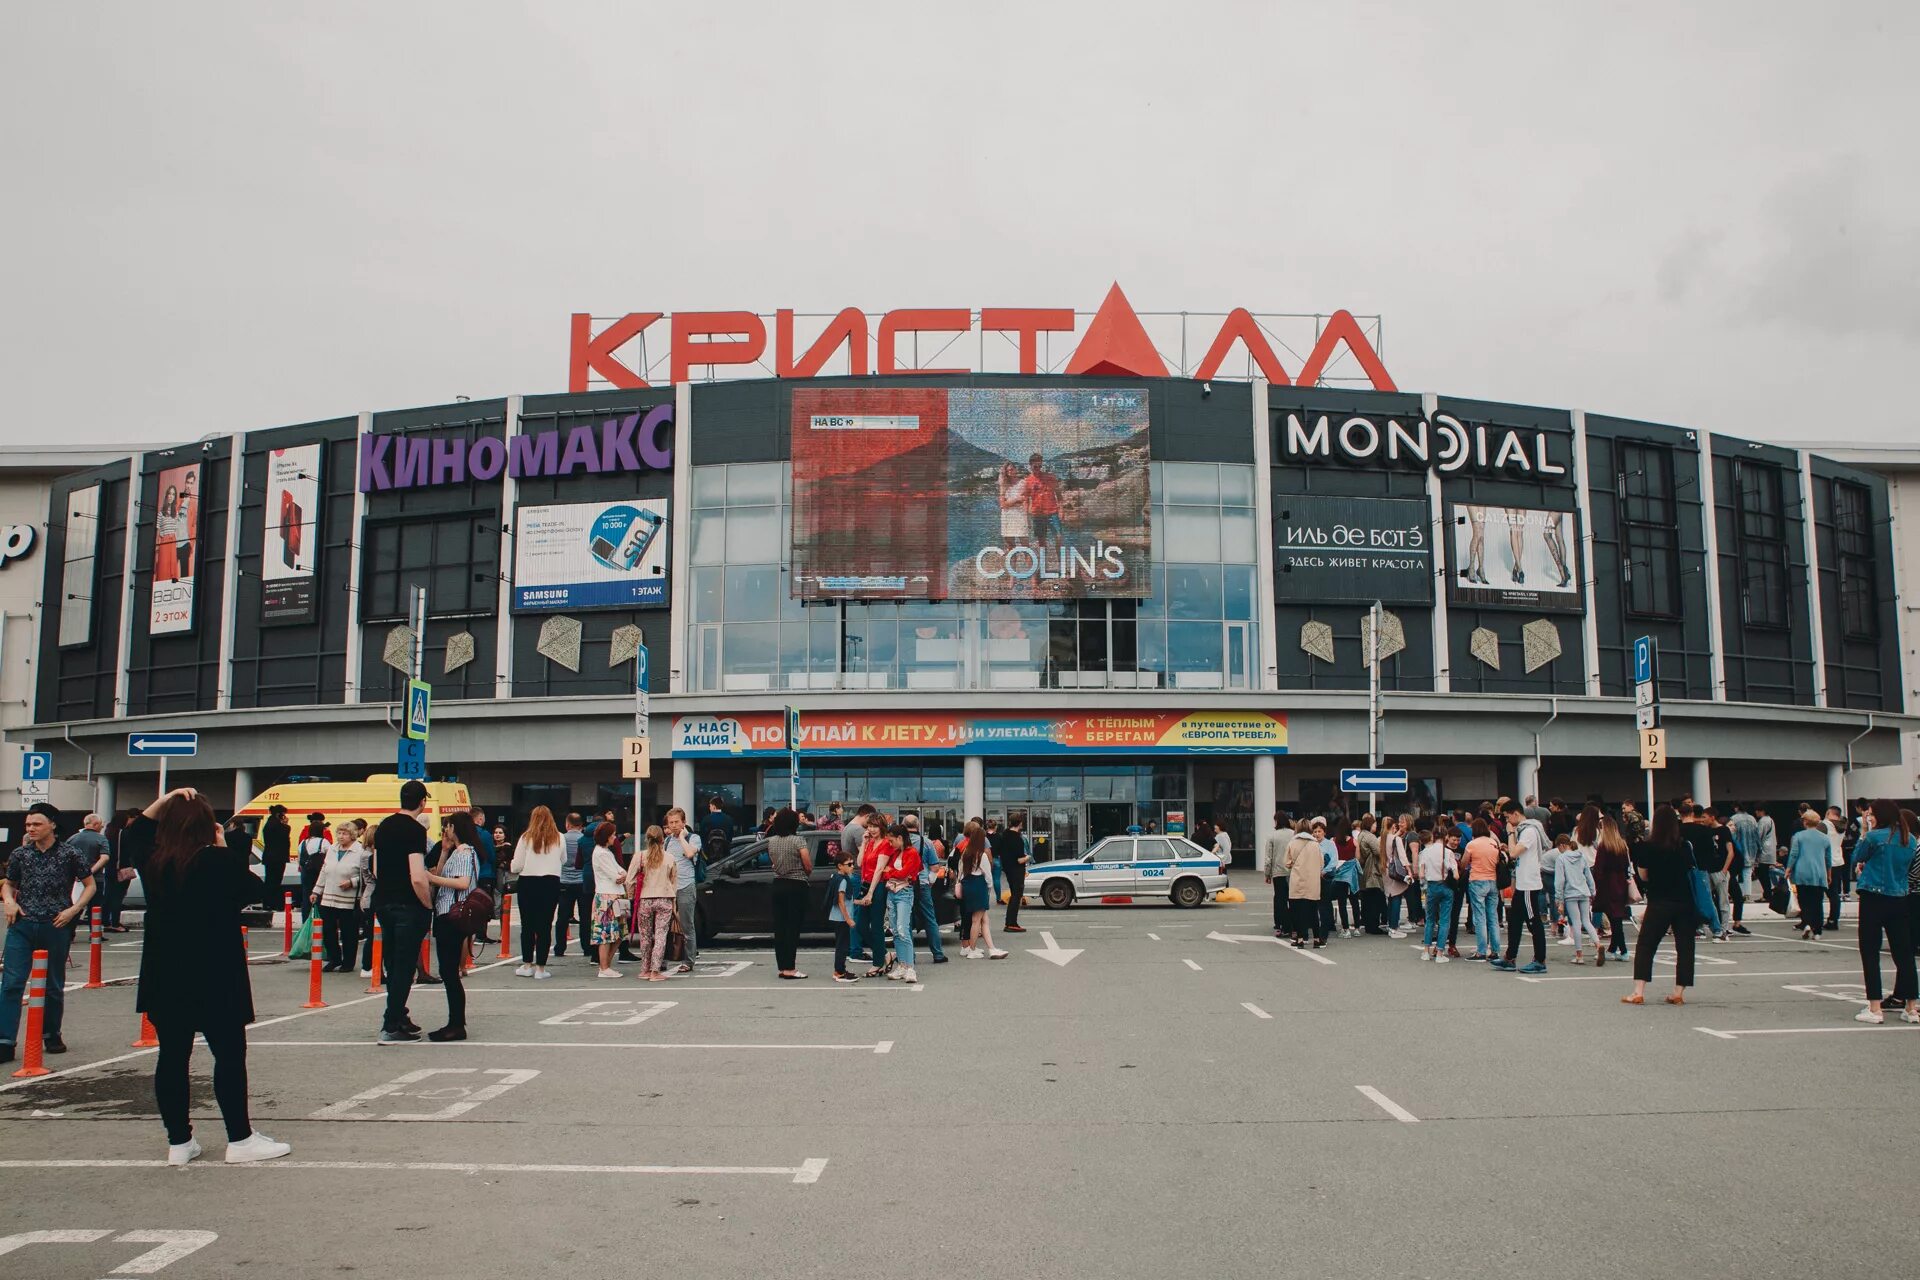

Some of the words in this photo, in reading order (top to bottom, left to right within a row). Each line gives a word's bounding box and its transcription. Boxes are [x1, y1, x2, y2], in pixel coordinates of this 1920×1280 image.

[569, 280, 1399, 393] КРИСТАЛЛ
[1092, 395, 1097, 406] 1
[360, 404, 674, 493] КИНОМАКС
[1287, 413, 1565, 474] MONDIAL
[1287, 526, 1328, 544] ИЛЬ
[624, 529, 650, 558] S10
[975, 540, 1125, 579] COLIN'S
[1288, 556, 1324, 567] ЗДЕСЬ
[1328, 557, 1367, 568] ЖИВЕТ
[1372, 559, 1424, 569] КРАСОТА
[523, 589, 569, 600] SAMSUNG
[632, 588, 636, 596] 1
[637, 586, 662, 595] ЭТАЖ
[155, 611, 160, 623] 2
[163, 611, 188, 622] этаж
[1639, 643, 1647, 677] P
[640, 650, 646, 684] P
[684, 723, 692, 733] У
[1086, 719, 1094, 728] К
[1098, 716, 1155, 728] ТЁПЛЫМ
[1191, 721, 1261, 730] путешествие
[752, 722, 857, 742] ПОУПАЙ
[862, 726, 876, 740] К
[881, 725, 938, 740] ЛЕТУ
[1086, 731, 1155, 741] БЕРЕГАМ
[1181, 731, 1230, 739] «ЕВРОПА
[1232, 731, 1277, 739] ТРЕВЕЛ»
[1648, 734, 1659, 747] D
[631, 742, 642, 755] D
[1649, 751, 1658, 763] 2
[30, 755, 45, 777] P
[404, 761, 419, 774] 13
[632, 760, 640, 772] 1
[268, 792, 280, 801] 112
[1142, 869, 1165, 877] 0024
